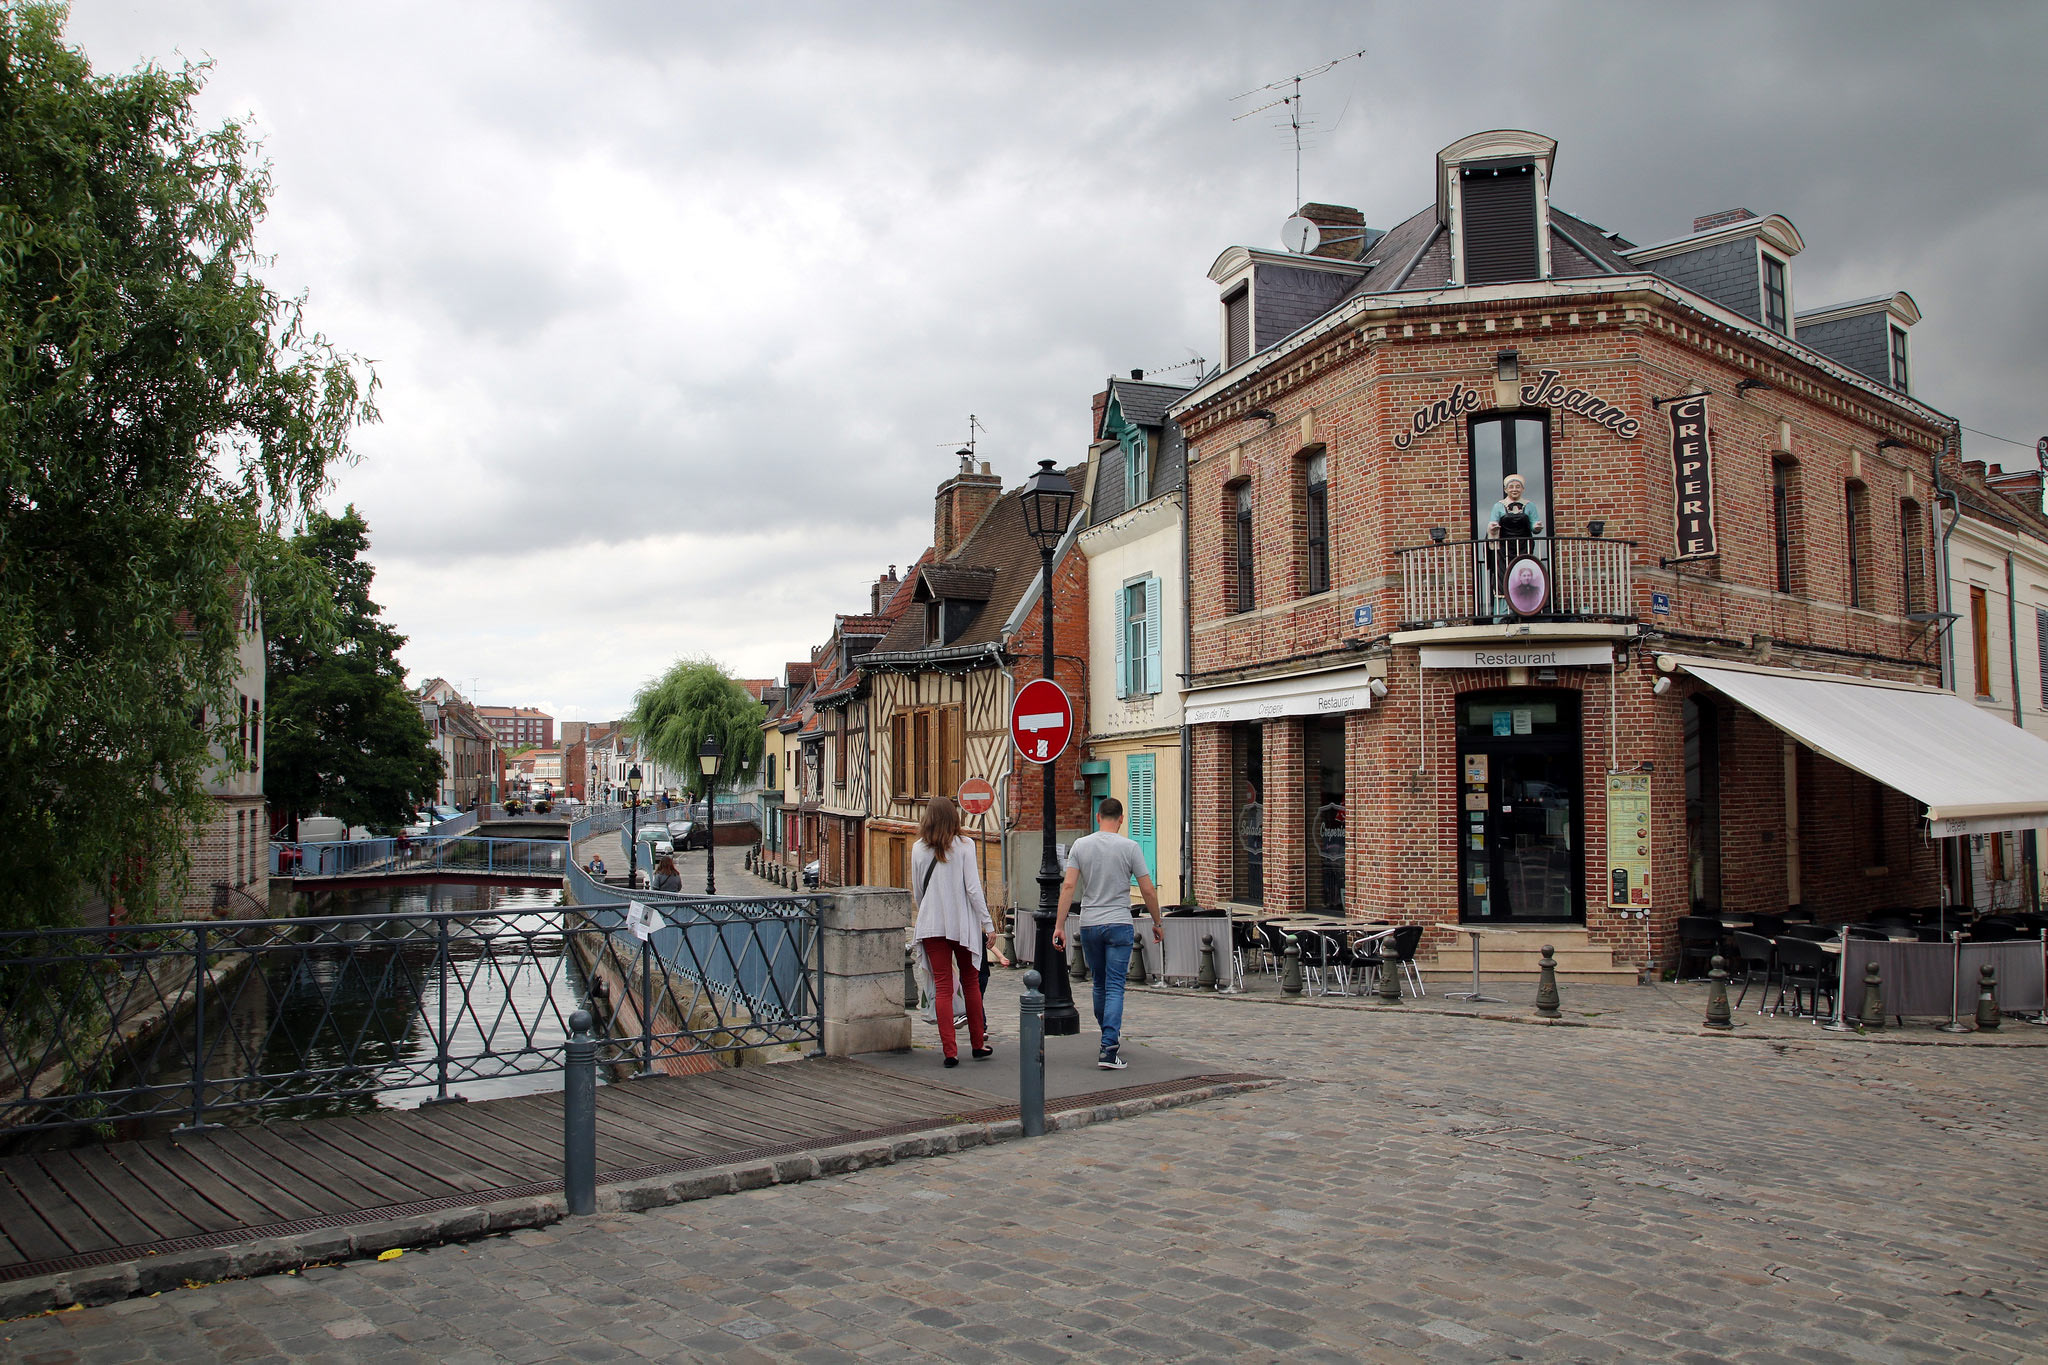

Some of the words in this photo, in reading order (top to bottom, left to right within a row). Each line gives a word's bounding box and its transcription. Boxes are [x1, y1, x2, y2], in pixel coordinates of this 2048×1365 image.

[1520, 368, 1640, 438] Jeanne
[1676, 403, 1705, 553] CREPERIE
[1474, 651, 1557, 666] Restaurant
[1318, 693, 1355, 710] Restaurant
